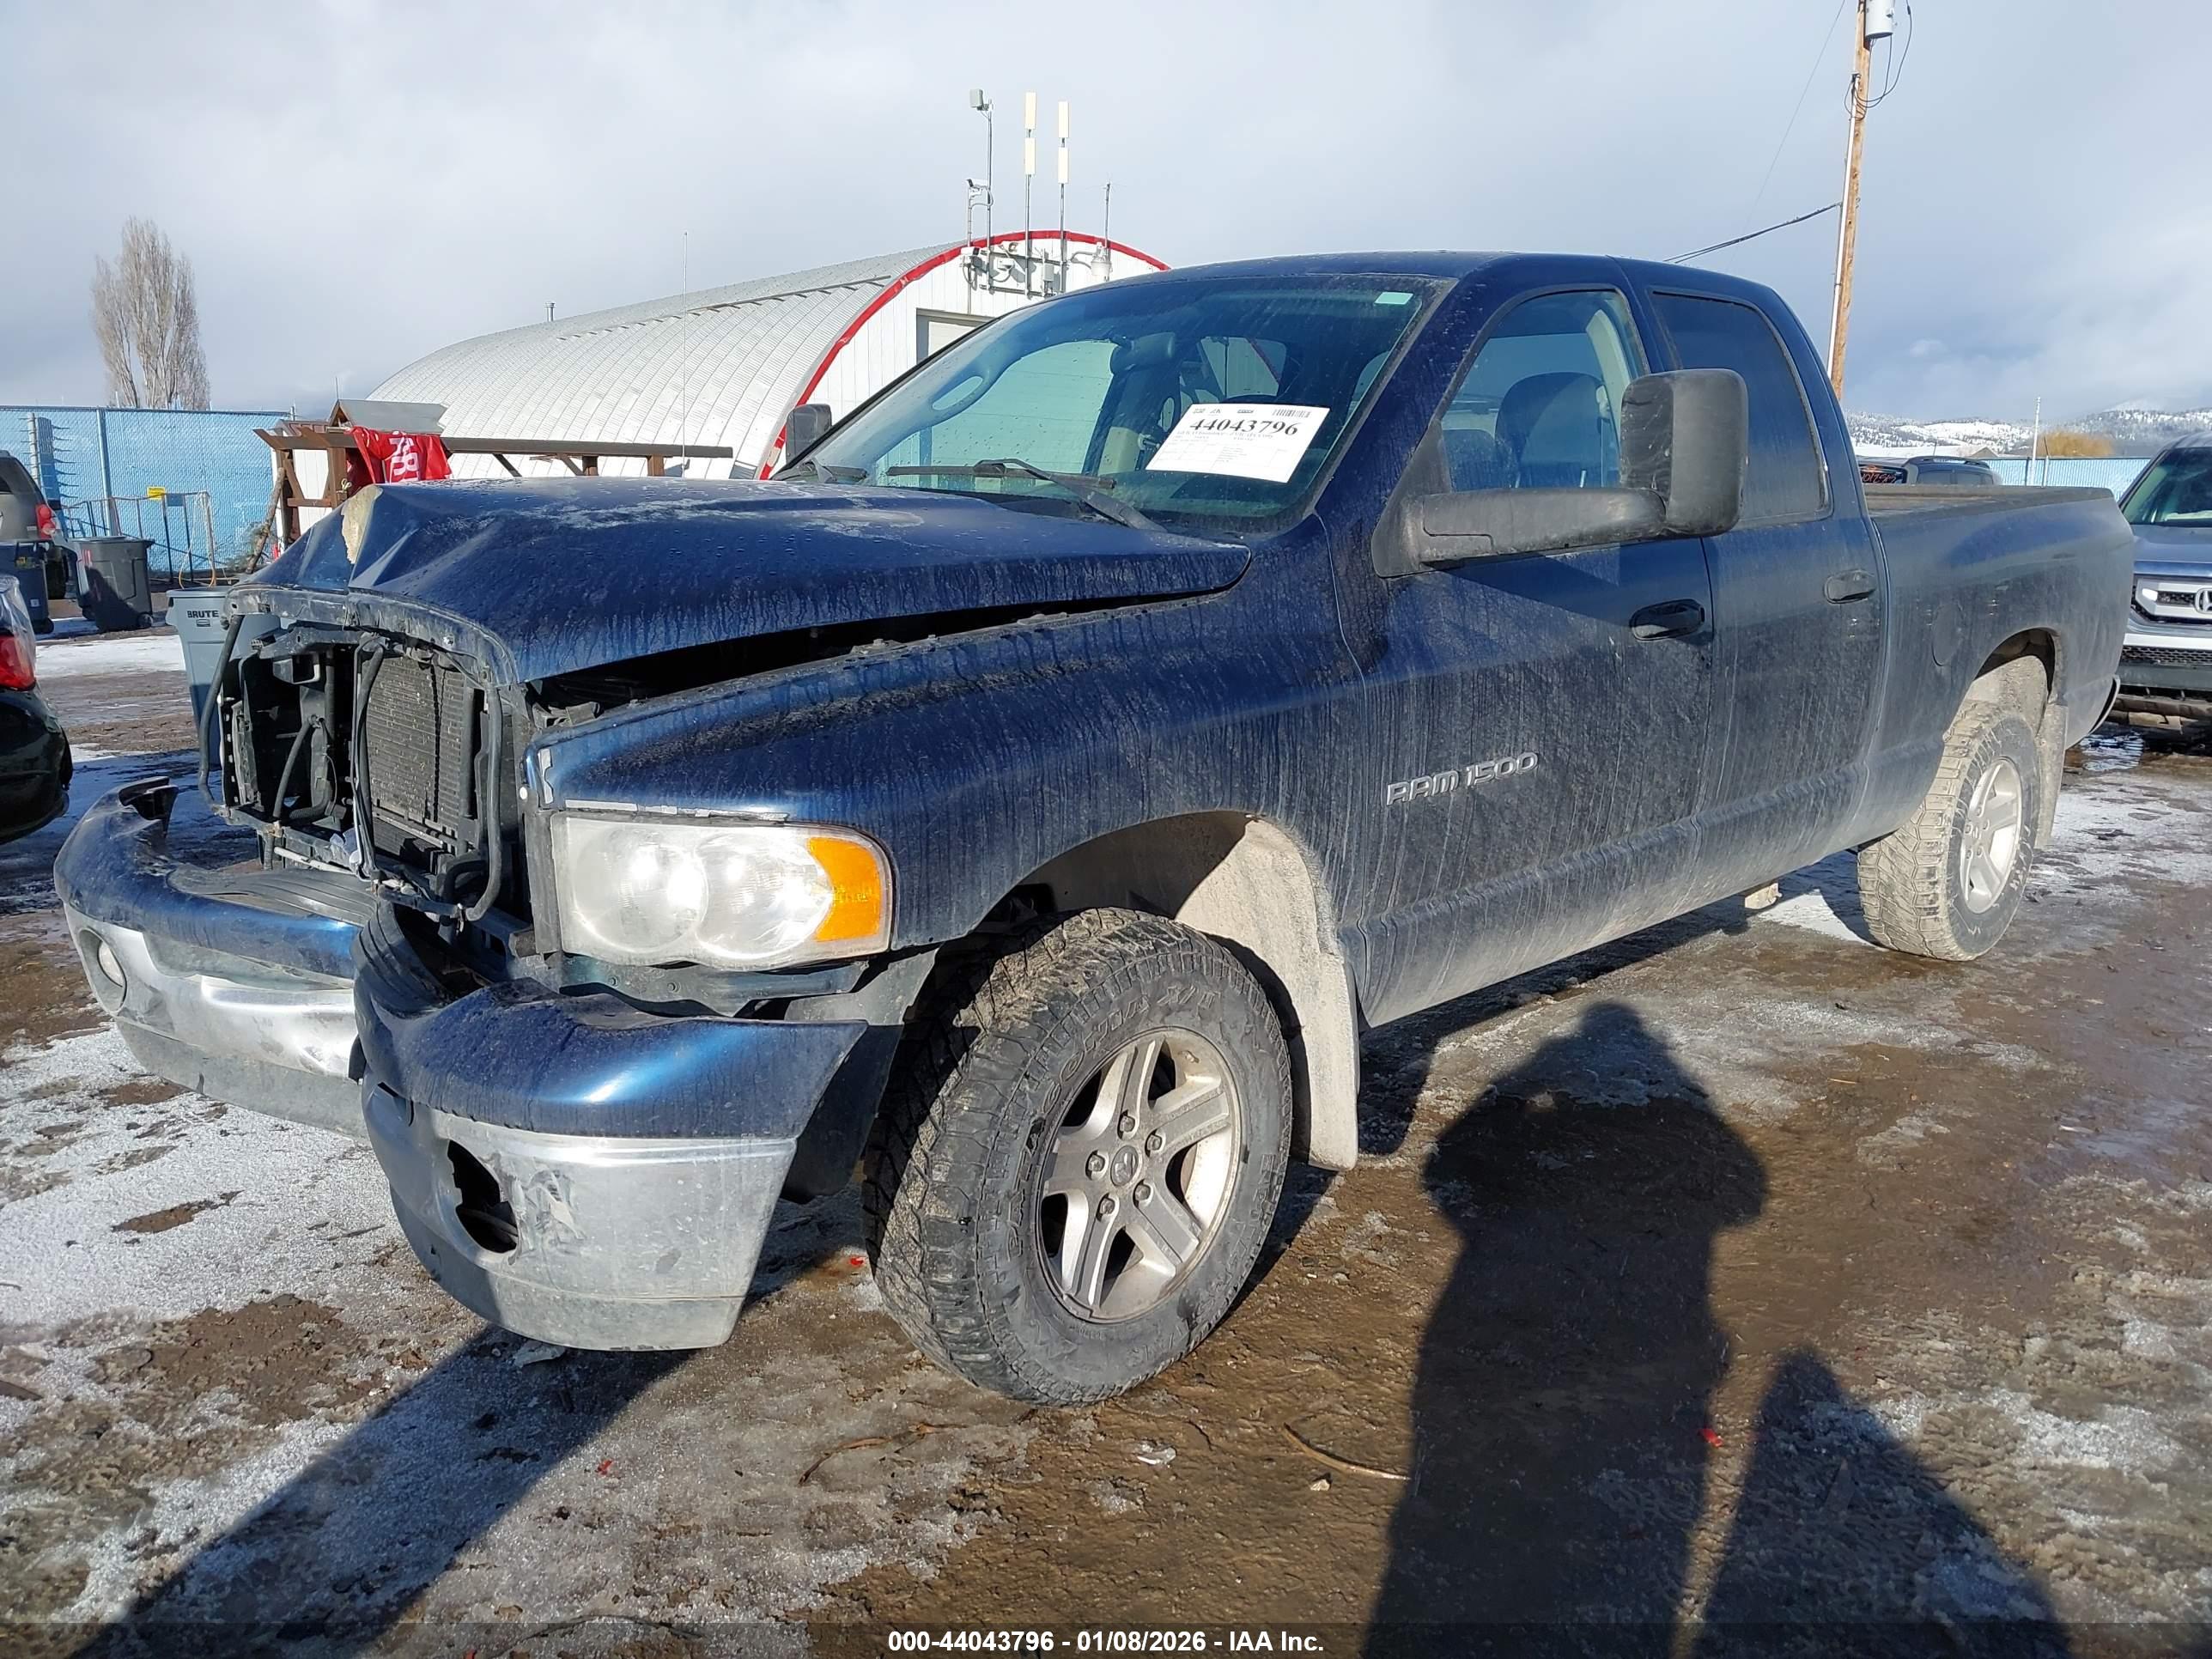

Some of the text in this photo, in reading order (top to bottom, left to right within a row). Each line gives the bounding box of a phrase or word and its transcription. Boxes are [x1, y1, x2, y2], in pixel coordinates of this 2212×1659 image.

[1190, 418, 1302, 435] 44043796
[1386, 751, 1540, 805] RAM 1500
